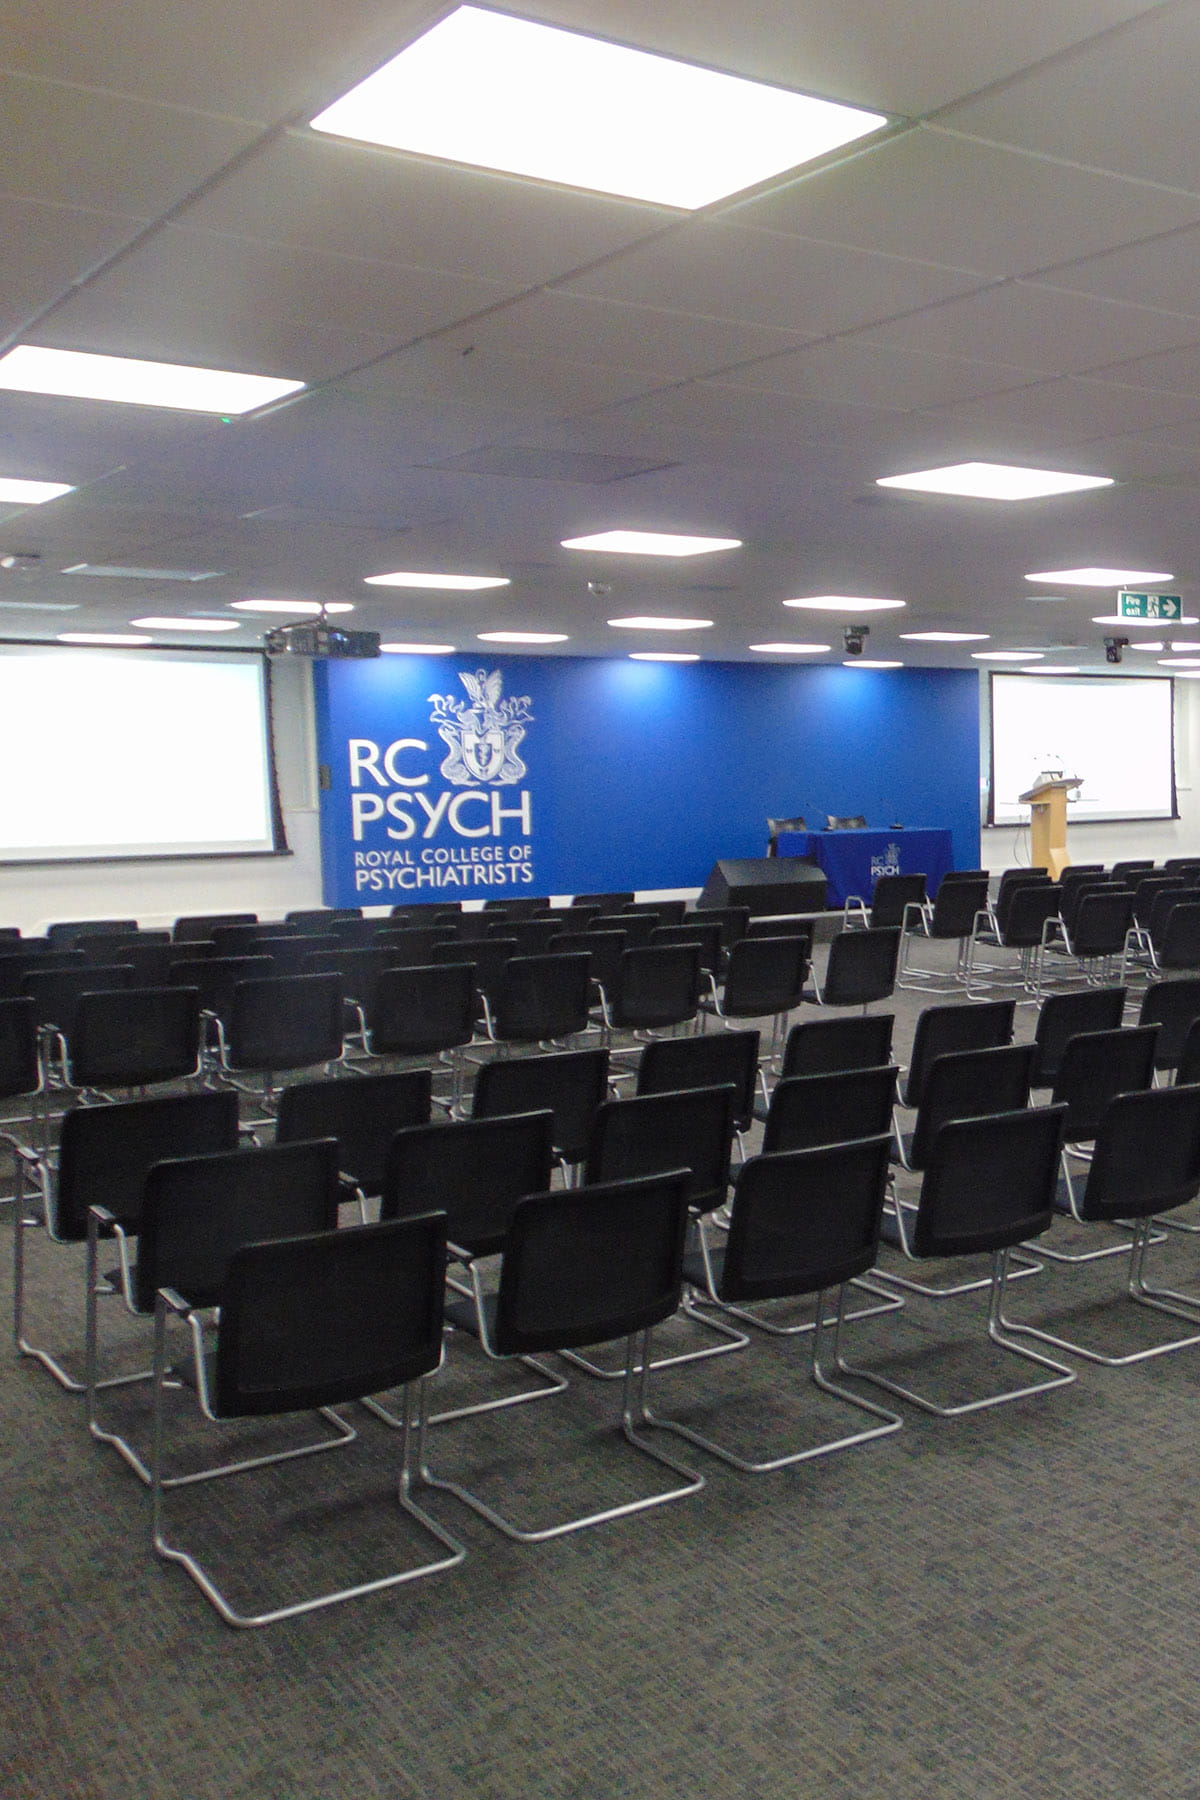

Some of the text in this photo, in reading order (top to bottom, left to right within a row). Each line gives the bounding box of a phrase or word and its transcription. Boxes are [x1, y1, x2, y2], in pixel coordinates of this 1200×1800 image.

[1126, 607, 1140, 616] exit
[349, 738, 430, 787] RC
[351, 790, 532, 841] PSYCH
[354, 845, 532, 867] ROYAL COLLEGE OF
[355, 862, 534, 891] PSYCHIATRISTS
[871, 865, 900, 876] PSYCH
